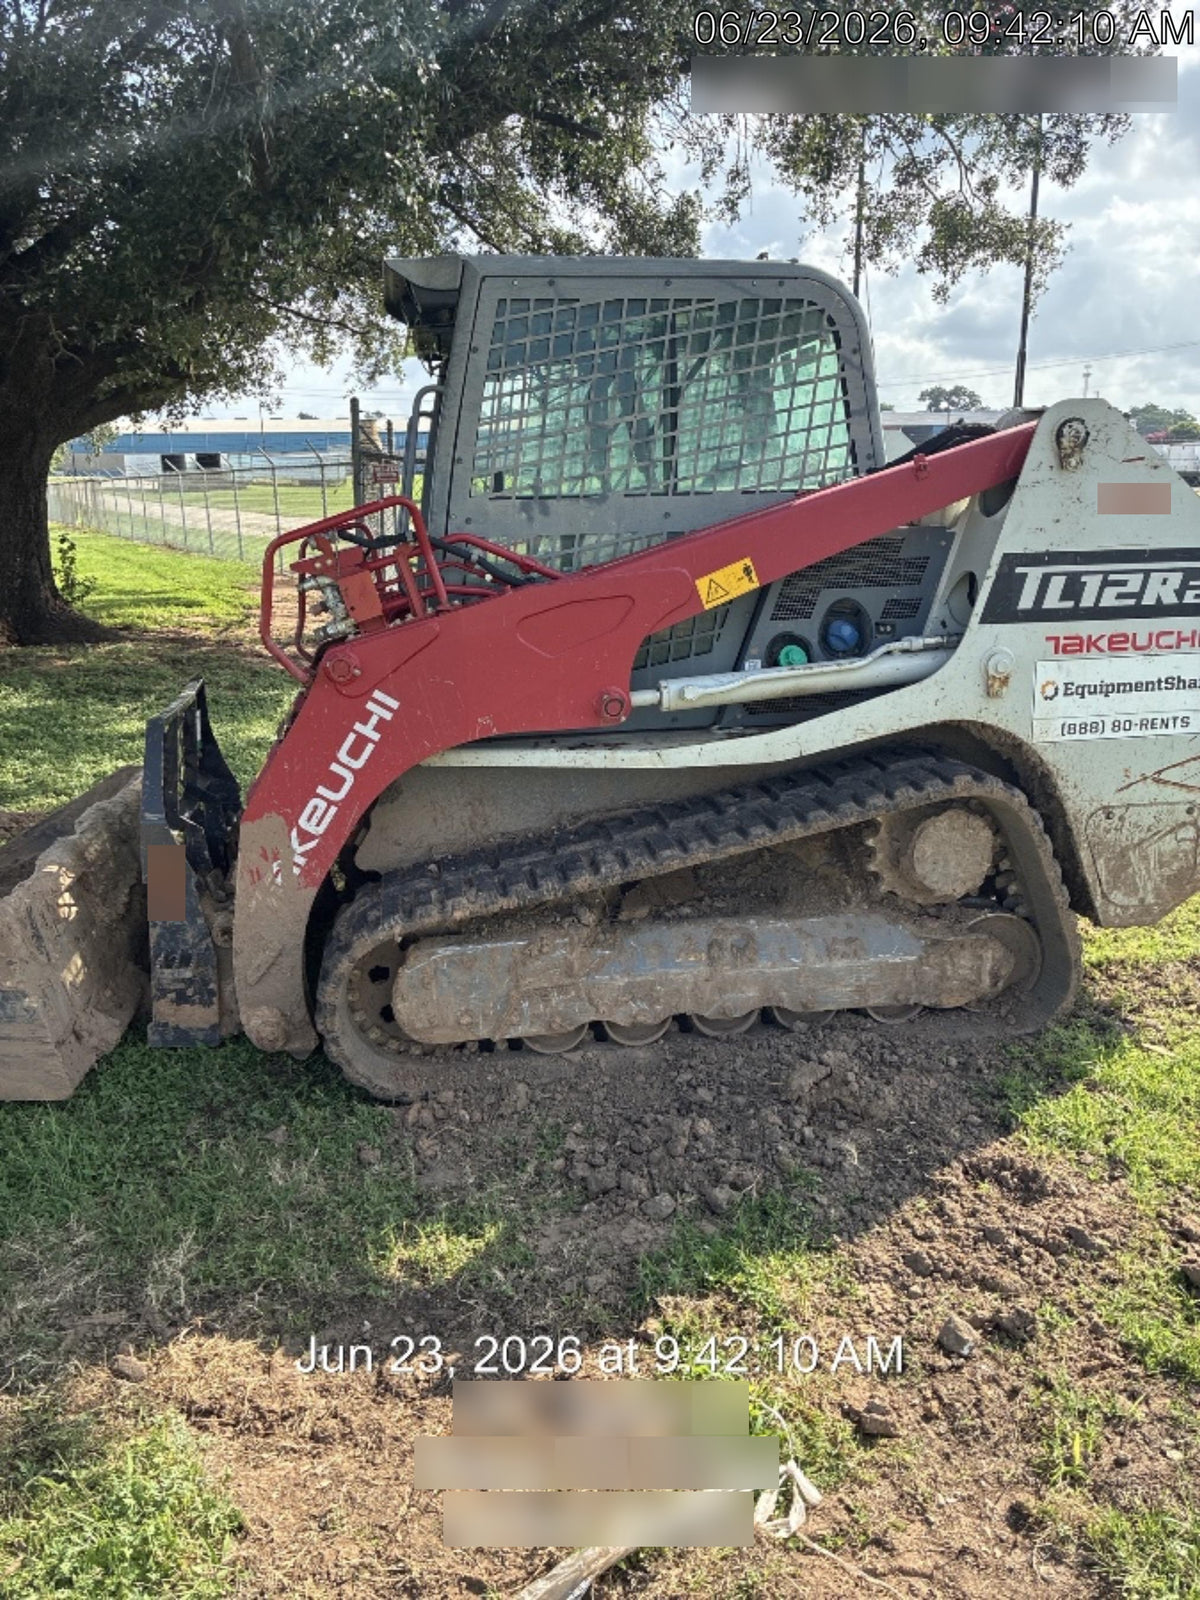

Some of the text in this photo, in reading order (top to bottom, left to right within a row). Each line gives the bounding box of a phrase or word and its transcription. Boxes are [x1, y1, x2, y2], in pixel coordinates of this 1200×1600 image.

[1062, 675, 1200, 699] EquipmentSha
[1061, 715, 1191, 736] (888) 80-RENTS
